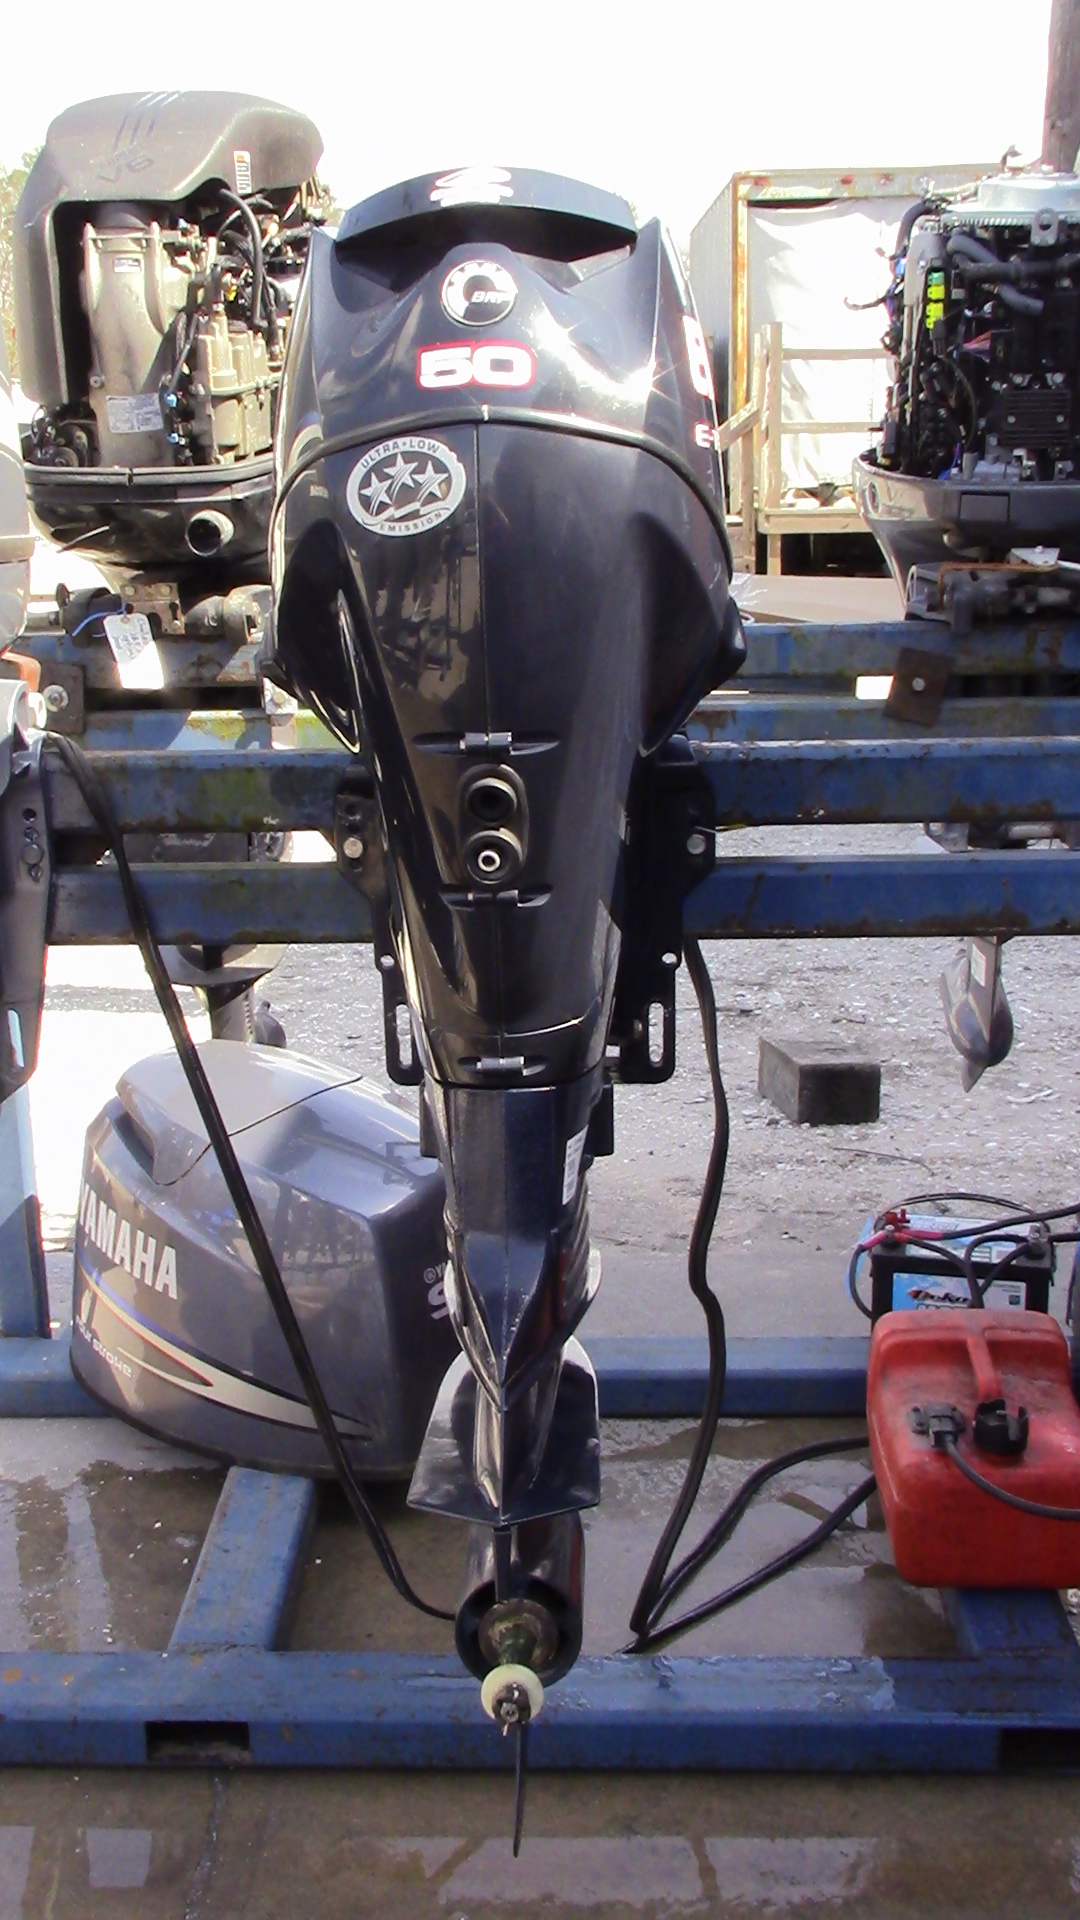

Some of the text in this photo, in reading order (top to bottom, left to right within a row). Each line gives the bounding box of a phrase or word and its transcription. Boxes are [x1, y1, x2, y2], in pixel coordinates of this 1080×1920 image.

[471, 291, 511, 304] BRP
[417, 341, 535, 388] 50
[360, 440, 440, 469] ULTRA LOW
[380, 511, 443, 533] EMISSION
[79, 1178, 178, 1300] YAMAHA
